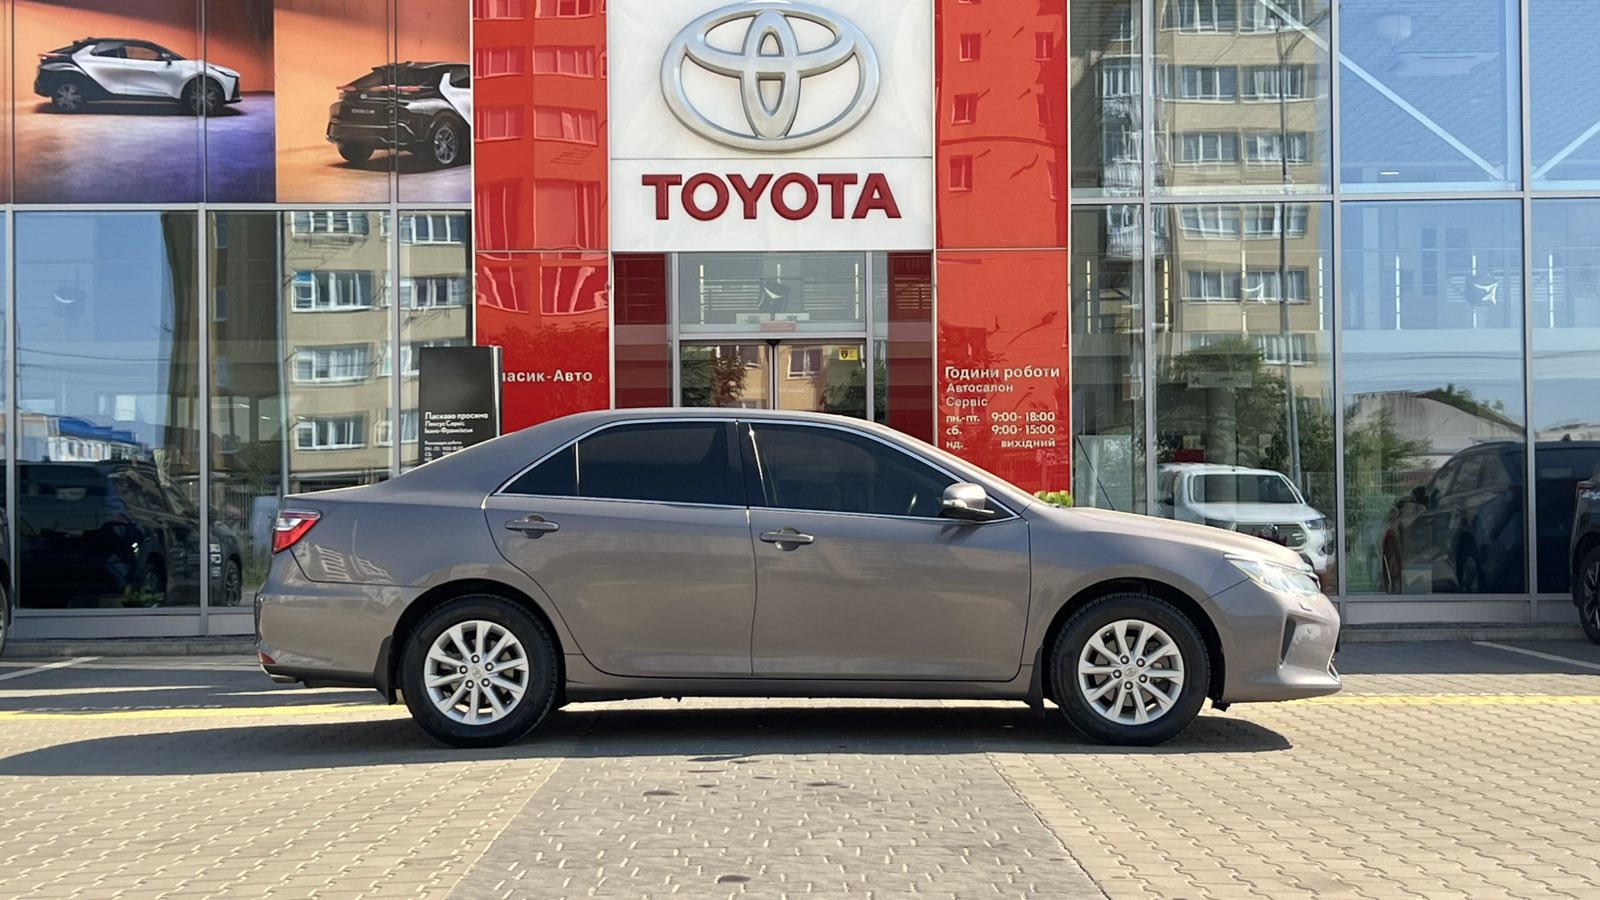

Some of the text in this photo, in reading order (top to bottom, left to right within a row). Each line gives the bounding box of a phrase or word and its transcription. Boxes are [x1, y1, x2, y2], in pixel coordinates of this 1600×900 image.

[642, 172, 902, 221] TOYOTA
[945, 365, 1060, 381] Години роботи
[946, 383, 1014, 393] Автосалон
[946, 397, 988, 409] Сервіс
[457, 413, 489, 421] просимо
[946, 426, 962, 435] сб.
[946, 438, 1056, 449] нд. вихідний
